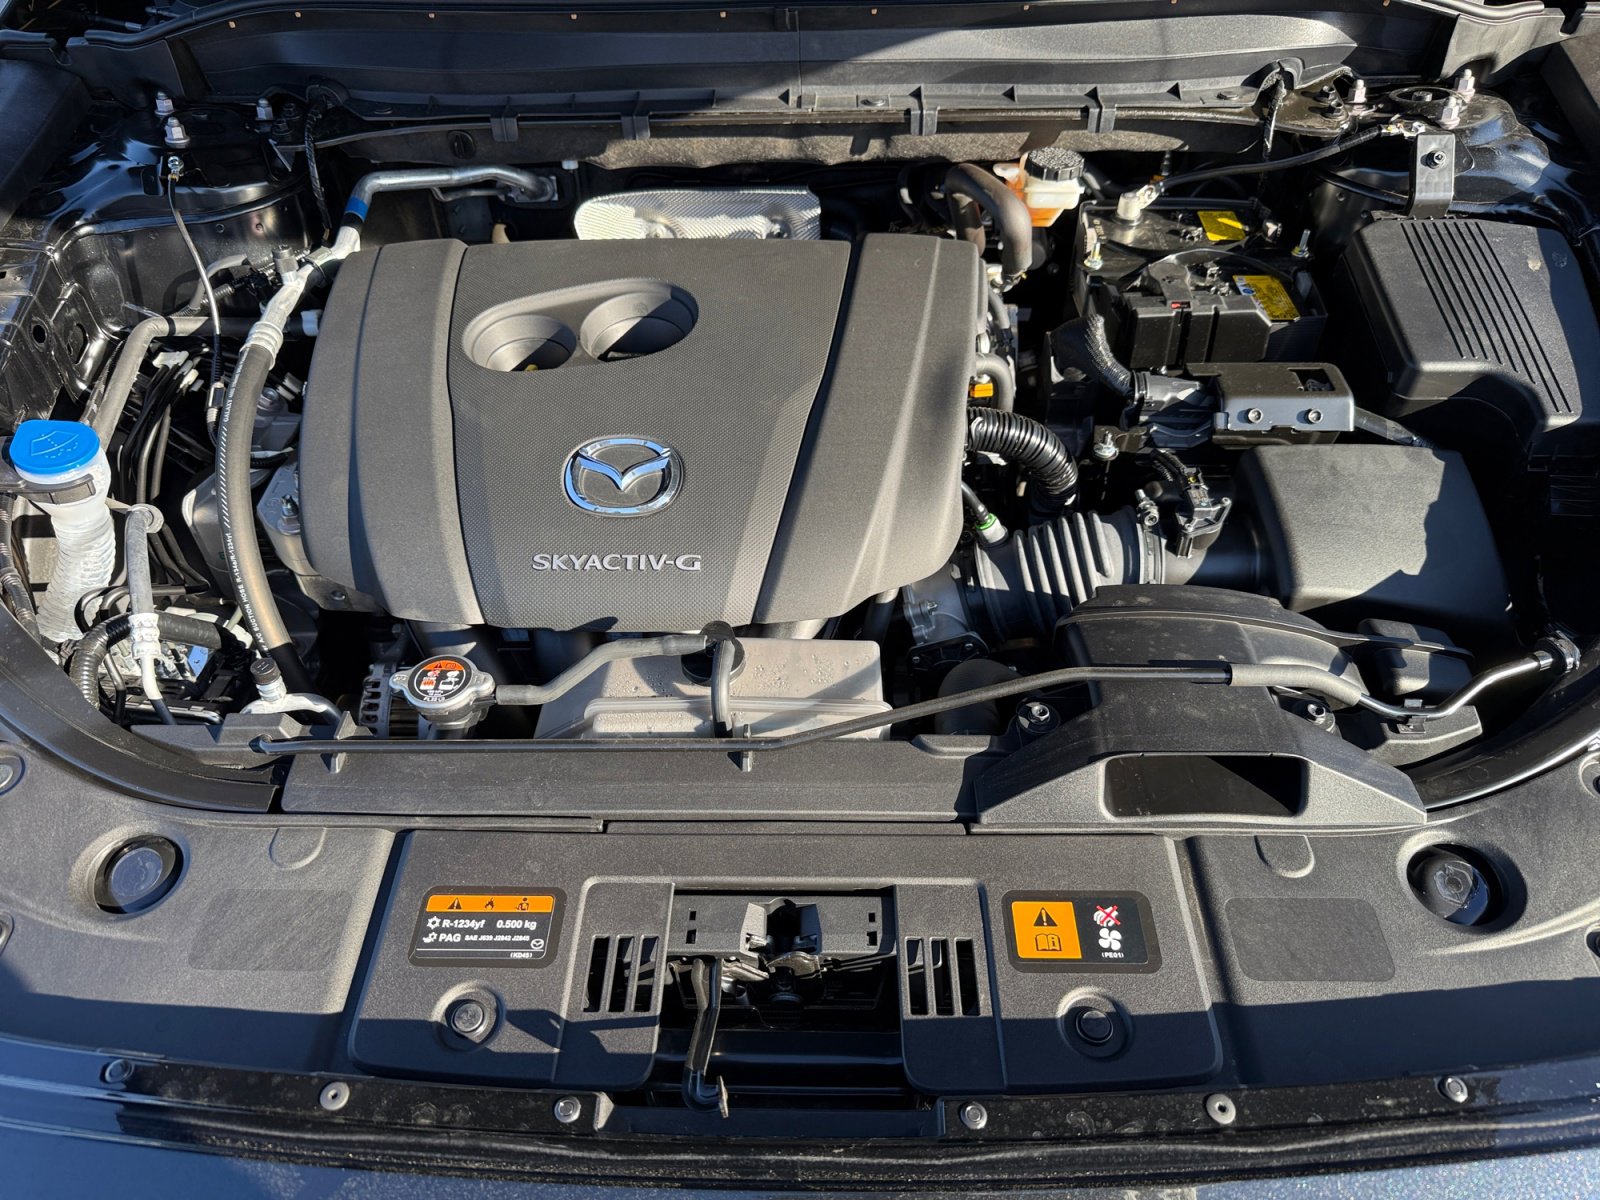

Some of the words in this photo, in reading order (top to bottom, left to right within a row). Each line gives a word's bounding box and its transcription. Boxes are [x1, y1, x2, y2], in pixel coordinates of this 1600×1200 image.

[223, 399, 233, 423] GALAXY
[531, 554, 702, 571] SKYACTIV-G
[237, 582, 247, 601] HOSE
[244, 603, 260, 633] SUCTION
[442, 919, 486, 930] R-1234yf
[496, 920, 523, 929] 0.500
[523, 920, 537, 930] kg
[439, 933, 462, 943] PAG
